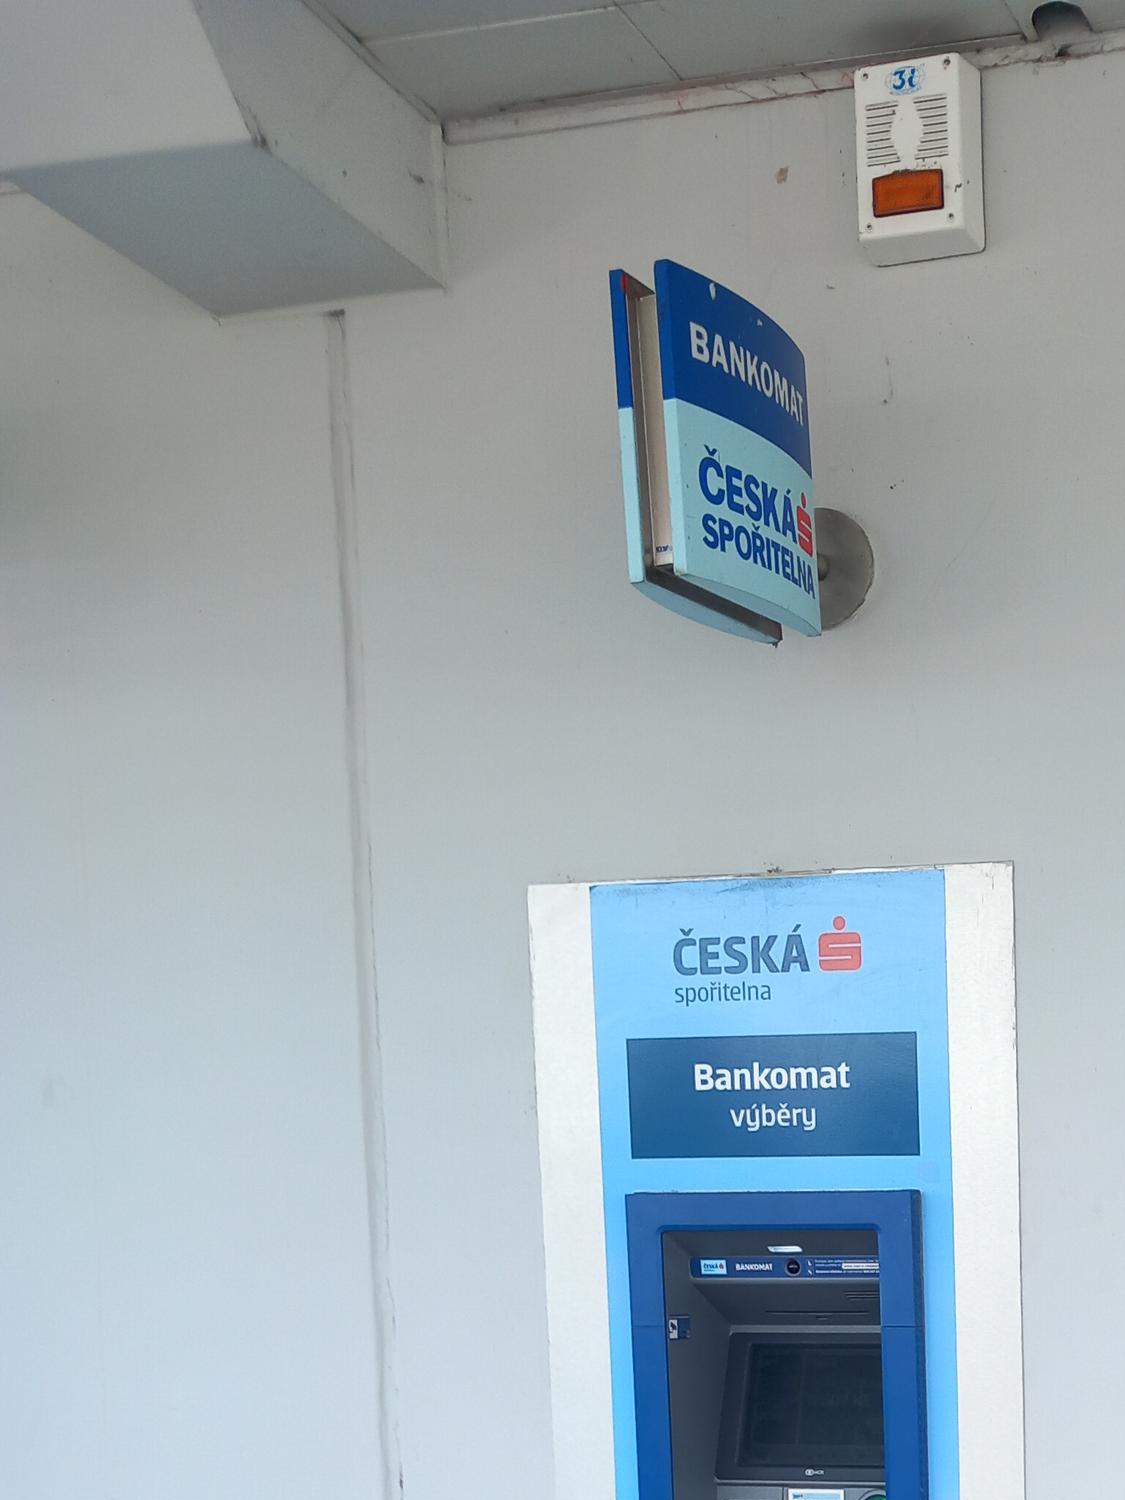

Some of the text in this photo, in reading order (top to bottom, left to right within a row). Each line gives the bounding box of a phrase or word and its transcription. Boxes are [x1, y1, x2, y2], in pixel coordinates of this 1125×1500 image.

[689, 320, 803, 426] BANKOMAT
[698, 444, 798, 545] ČESKÁ
[702, 513, 816, 600] SPOŘITELNA
[673, 923, 810, 976] ČESKÁ
[674, 981, 772, 1007] spořitelna
[694, 1061, 851, 1092] Bankomat
[730, 1103, 817, 1132] výběry
[735, 1263, 773, 1271] BANKOMAT
